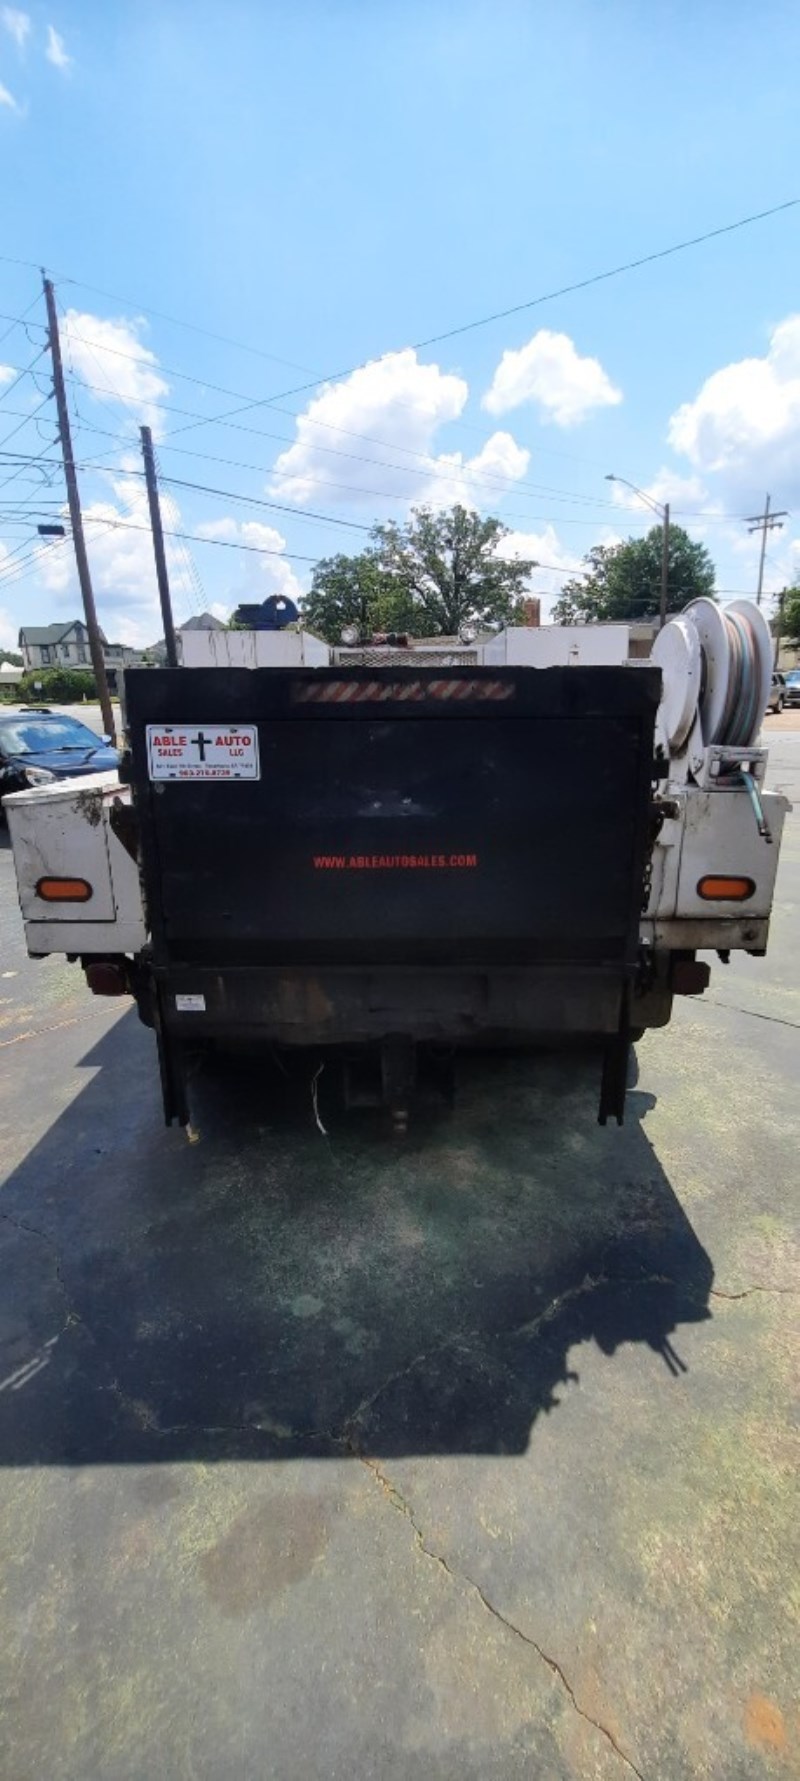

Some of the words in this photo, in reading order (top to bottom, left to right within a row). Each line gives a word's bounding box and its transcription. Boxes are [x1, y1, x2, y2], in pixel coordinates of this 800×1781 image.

[153, 736, 188, 746] ABLE
[215, 736, 251, 746] AUTO
[158, 748, 183, 757] SALES
[229, 748, 244, 757] LLC
[313, 854, 477, 868] WWW.ABLEAUTOSALES.COM
